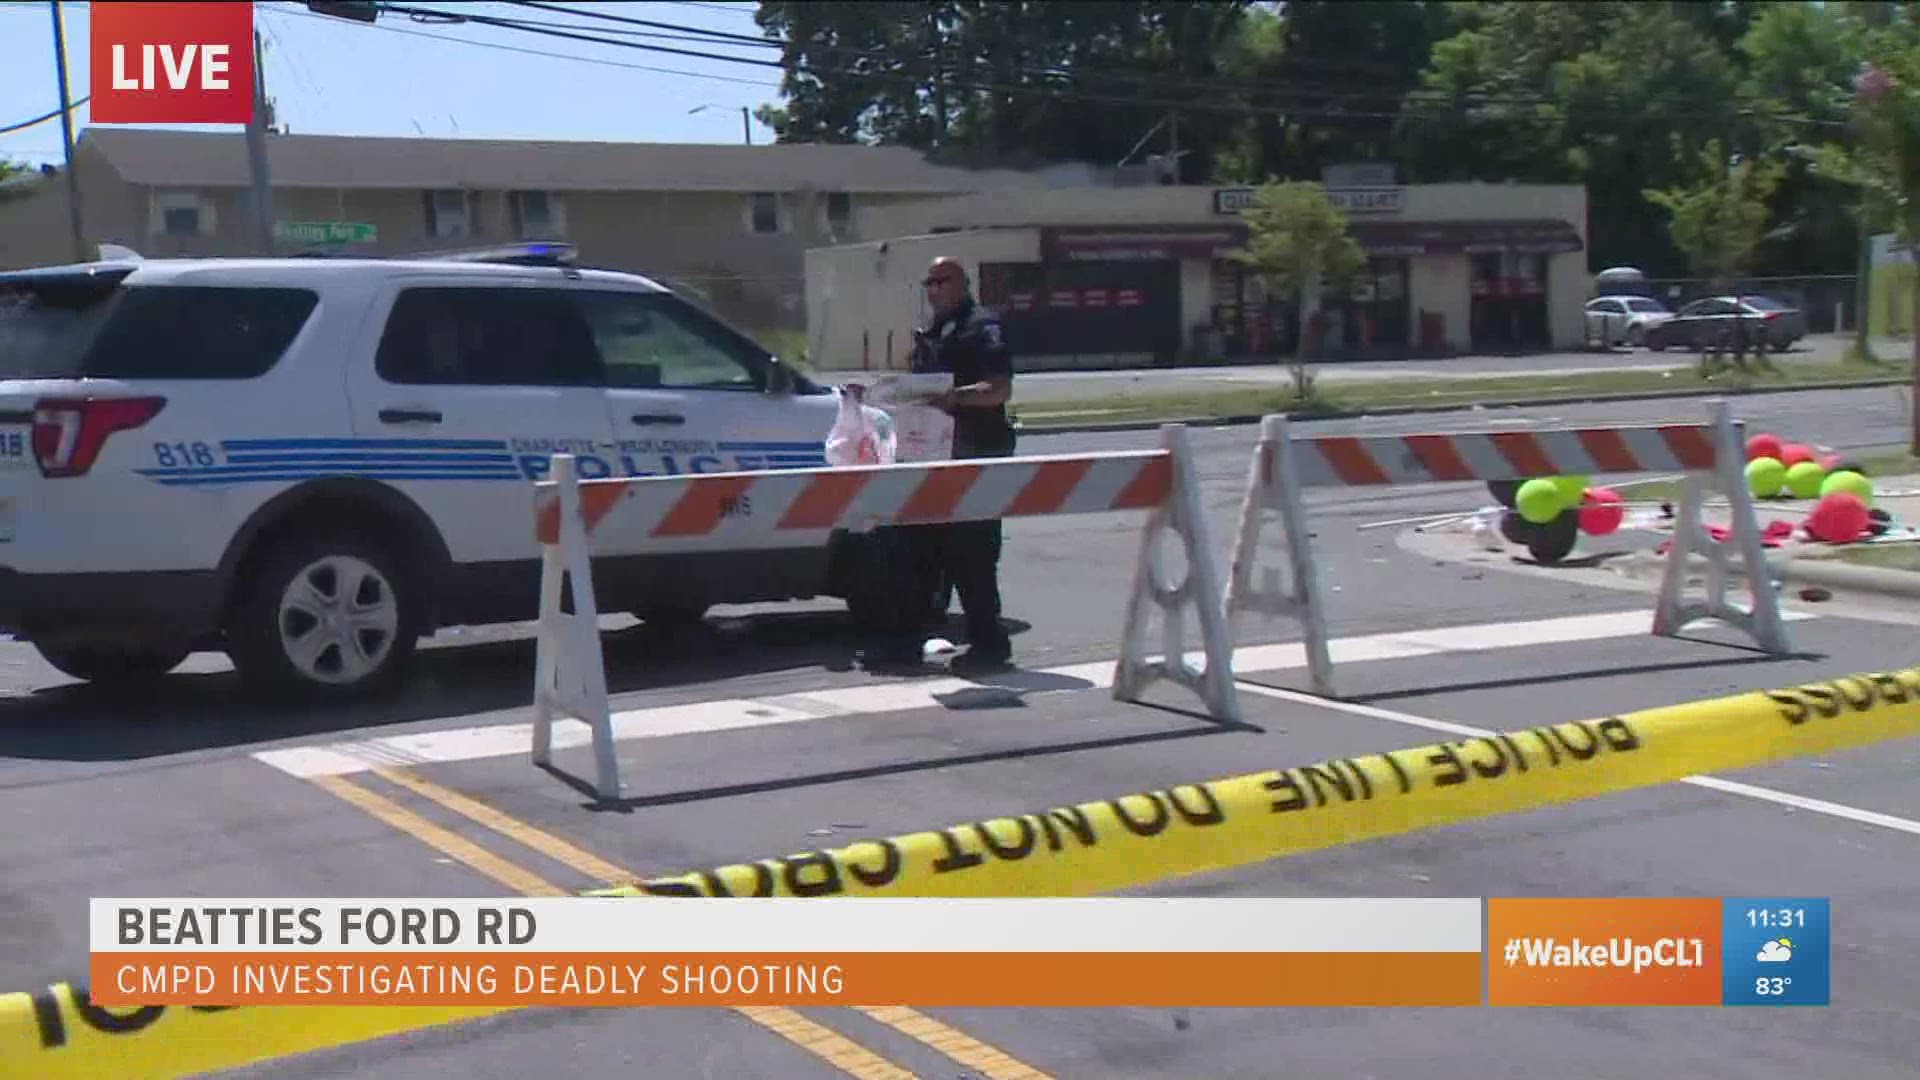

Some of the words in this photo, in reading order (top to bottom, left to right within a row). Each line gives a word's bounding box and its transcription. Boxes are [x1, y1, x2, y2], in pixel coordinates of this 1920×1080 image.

[153, 441, 215, 467] 818
[519, 454, 763, 481] POLICE
[1770, 669, 1920, 725] ROSS
[1429, 716, 1641, 788] POLICE
[1113, 783, 1227, 837] DO
[1263, 751, 1409, 814] LINE
[932, 806, 1096, 875] NOT
